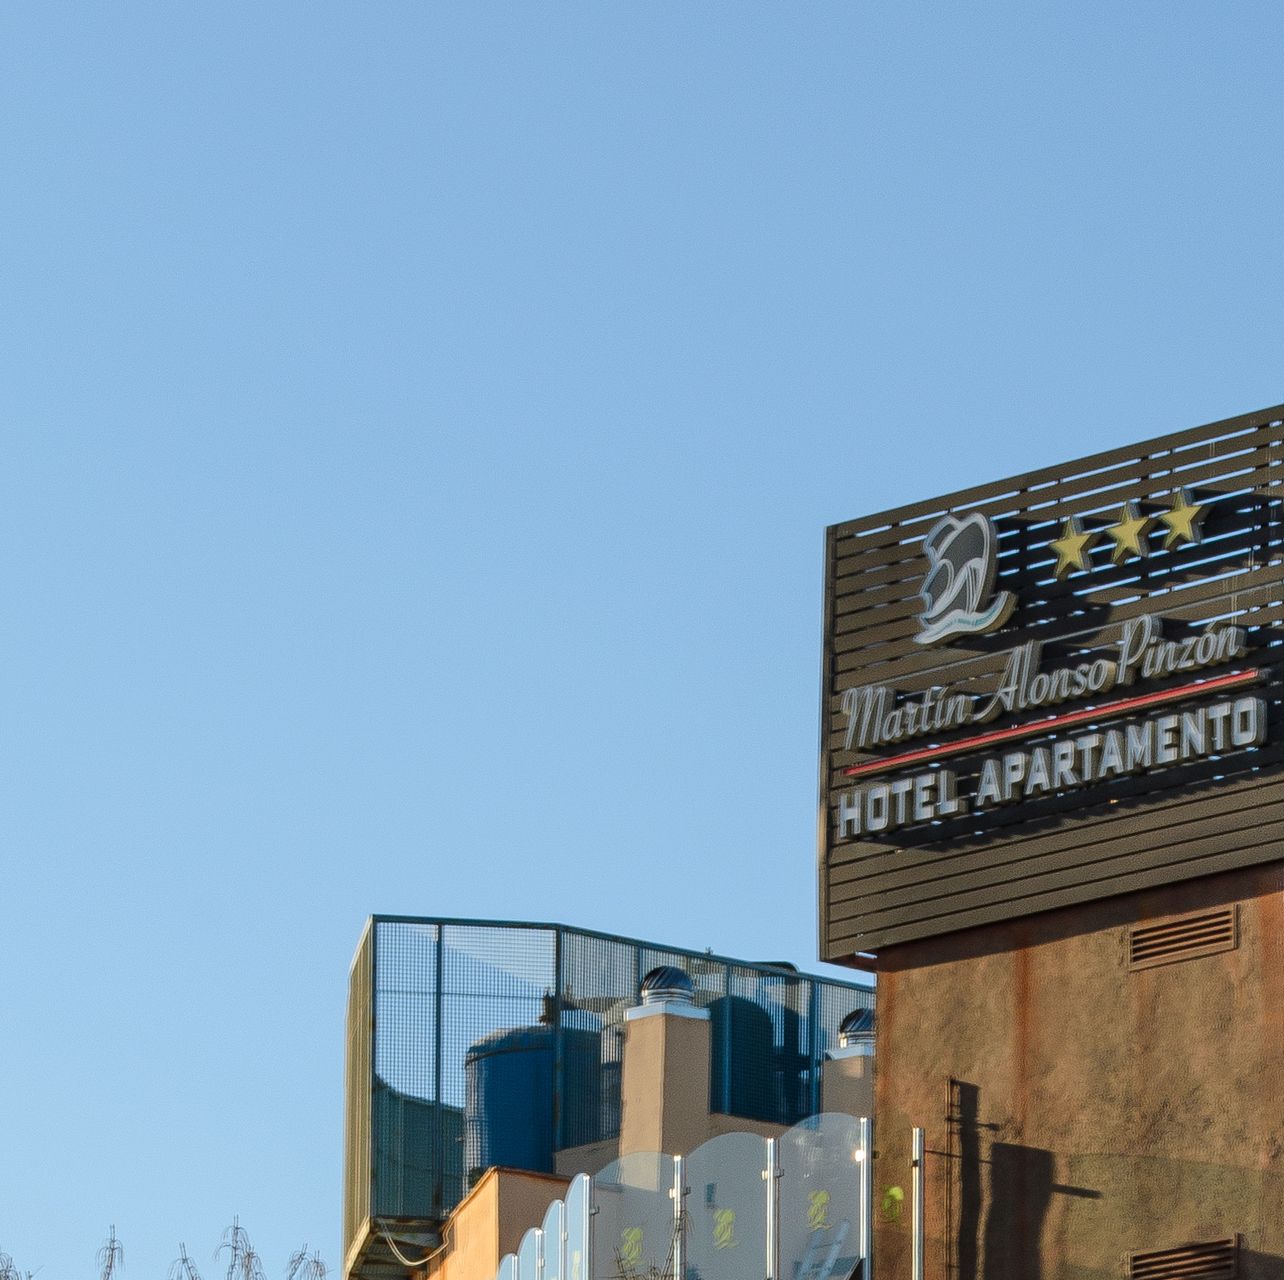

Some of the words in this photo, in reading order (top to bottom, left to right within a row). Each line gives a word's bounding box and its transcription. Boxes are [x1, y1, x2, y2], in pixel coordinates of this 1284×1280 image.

[841, 686, 976, 751] Martín
[971, 639, 1114, 722] Alonso
[1115, 614, 1246, 686] Pinzón
[839, 771, 963, 839] HOTEL
[977, 696, 1268, 806] APARTAMENTO
